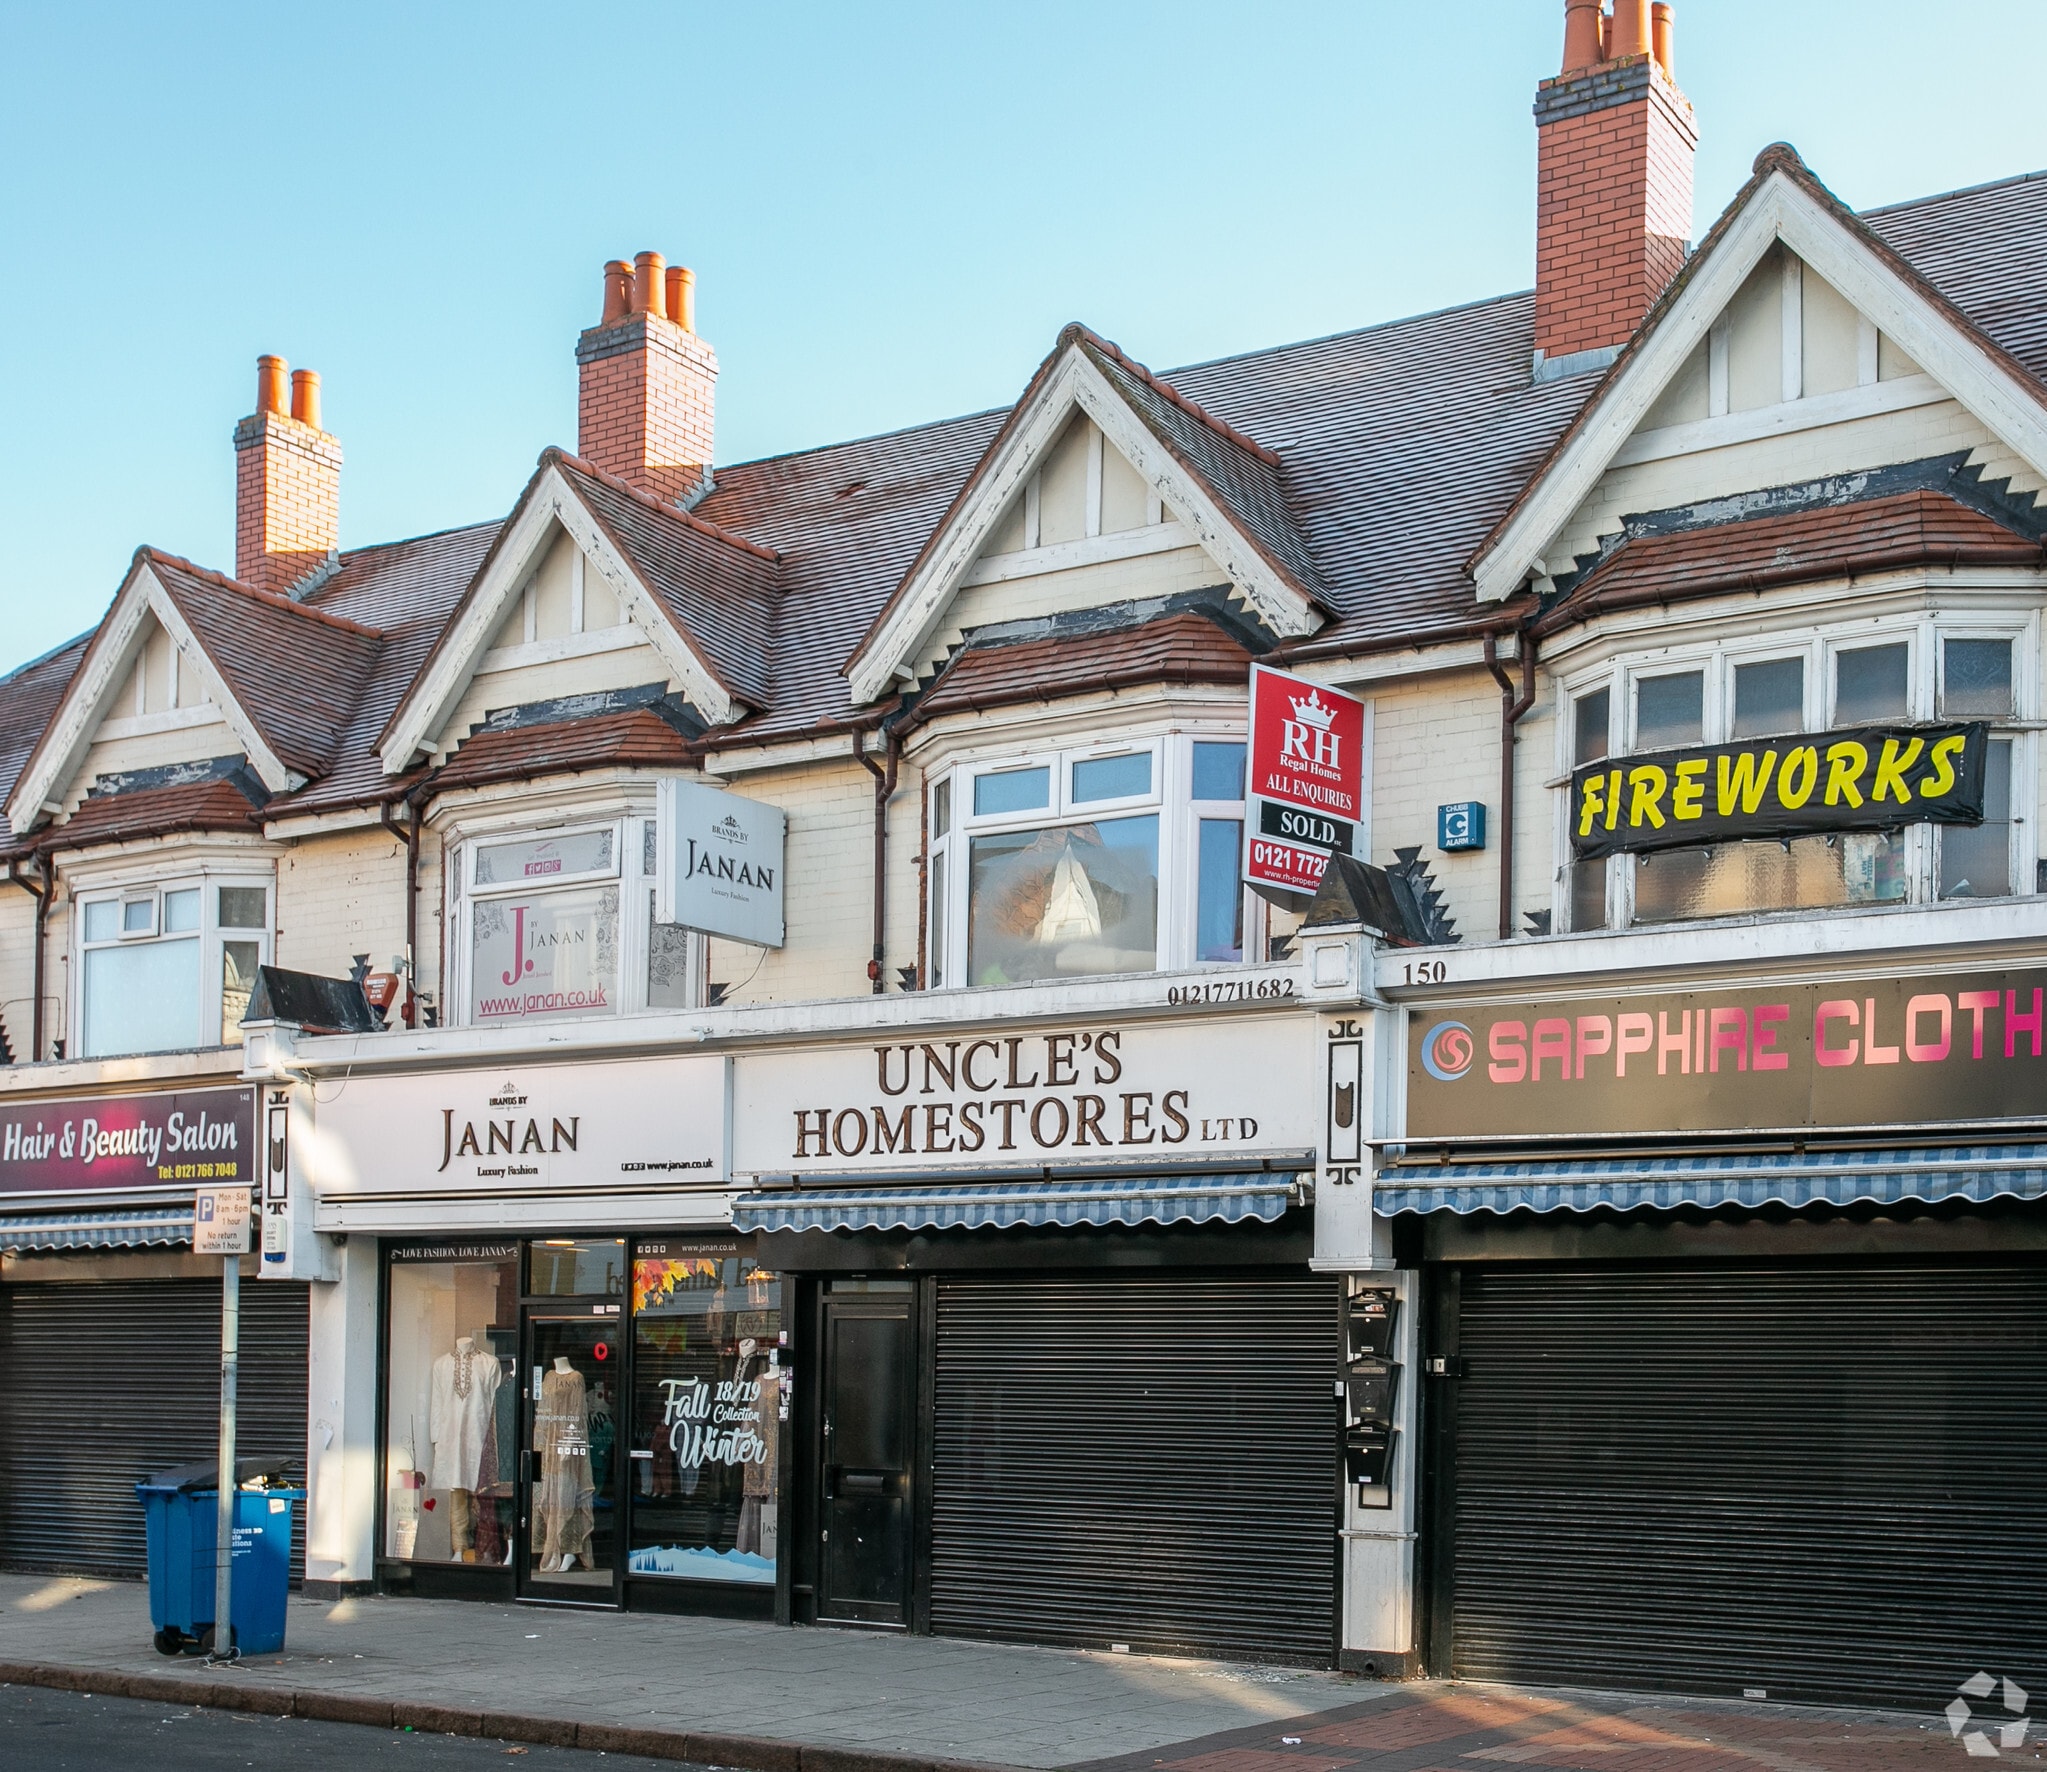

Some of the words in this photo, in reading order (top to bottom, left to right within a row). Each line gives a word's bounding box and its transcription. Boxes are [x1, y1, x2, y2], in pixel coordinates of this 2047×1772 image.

[1280, 718, 1343, 770] RH
[1280, 754, 1308, 772] Regal
[1310, 762, 1342, 782] Homes
[1266, 773, 1291, 794] ALL
[1293, 779, 1353, 811] ENQUIRIES
[1578, 735, 1967, 837] FIREWORKS
[1445, 803, 1469, 813] CHUBB
[712, 824, 739, 840] BRANDS
[740, 832, 749, 842] BY
[1281, 811, 1336, 844] SOLD
[1445, 837, 1469, 847] ALARM
[685, 837, 775, 893] JANAN
[1254, 843, 1291, 870] 0121
[711, 887, 729, 899] Luxury
[730, 891, 750, 902] Fashion
[530, 920, 538, 928] BY
[530, 929, 585, 951] JANAN
[1402, 960, 1447, 986] 150
[479, 982, 607, 1017] www.janan.co.uk
[1167, 978, 1294, 1006] 01217711682
[1488, 1002, 1790, 1084] SAPPHIRE
[874, 1030, 1123, 1097] UNCLE'S
[518, 1096, 528, 1105] BY
[792, 1090, 1190, 1158] HOMESTORES
[1200, 1116, 1258, 1141] LTD
[3, 1121, 56, 1161] Hair
[59, 1120, 76, 1158] &
[80, 1118, 163, 1168] Beauty
[166, 1111, 238, 1152] Salon
[437, 1109, 580, 1173] JANAN
[158, 1165, 174, 1179] Tel:
[175, 1163, 196, 1178] 0121
[197, 1163, 214, 1178] 766
[215, 1162, 237, 1177] 7048
[477, 1167, 506, 1178] Luxury
[508, 1165, 539, 1175] Fashion
[647, 1158, 713, 1172] www.janan.co.uk
[218, 1193, 232, 1201] Mon
[236, 1193, 247, 1201] Sat
[201, 1198, 213, 1220] P
[227, 1218, 241, 1226] hour
[203, 1242, 221, 1250] within
[226, 1241, 242, 1250] hour
[207, 1231, 217, 1239] No
[218, 1232, 238, 1240] return
[402, 1248, 423, 1258] LOVE
[459, 1247, 480, 1257] LOVE
[480, 1246, 507, 1257] JANAN
[682, 1243, 737, 1253] www.janan.co.uk
[658, 1375, 711, 1426] Fall
[714, 1381, 762, 1402] 18/19
[713, 1404, 761, 1424] Collection
[669, 1419, 768, 1469] Winter
